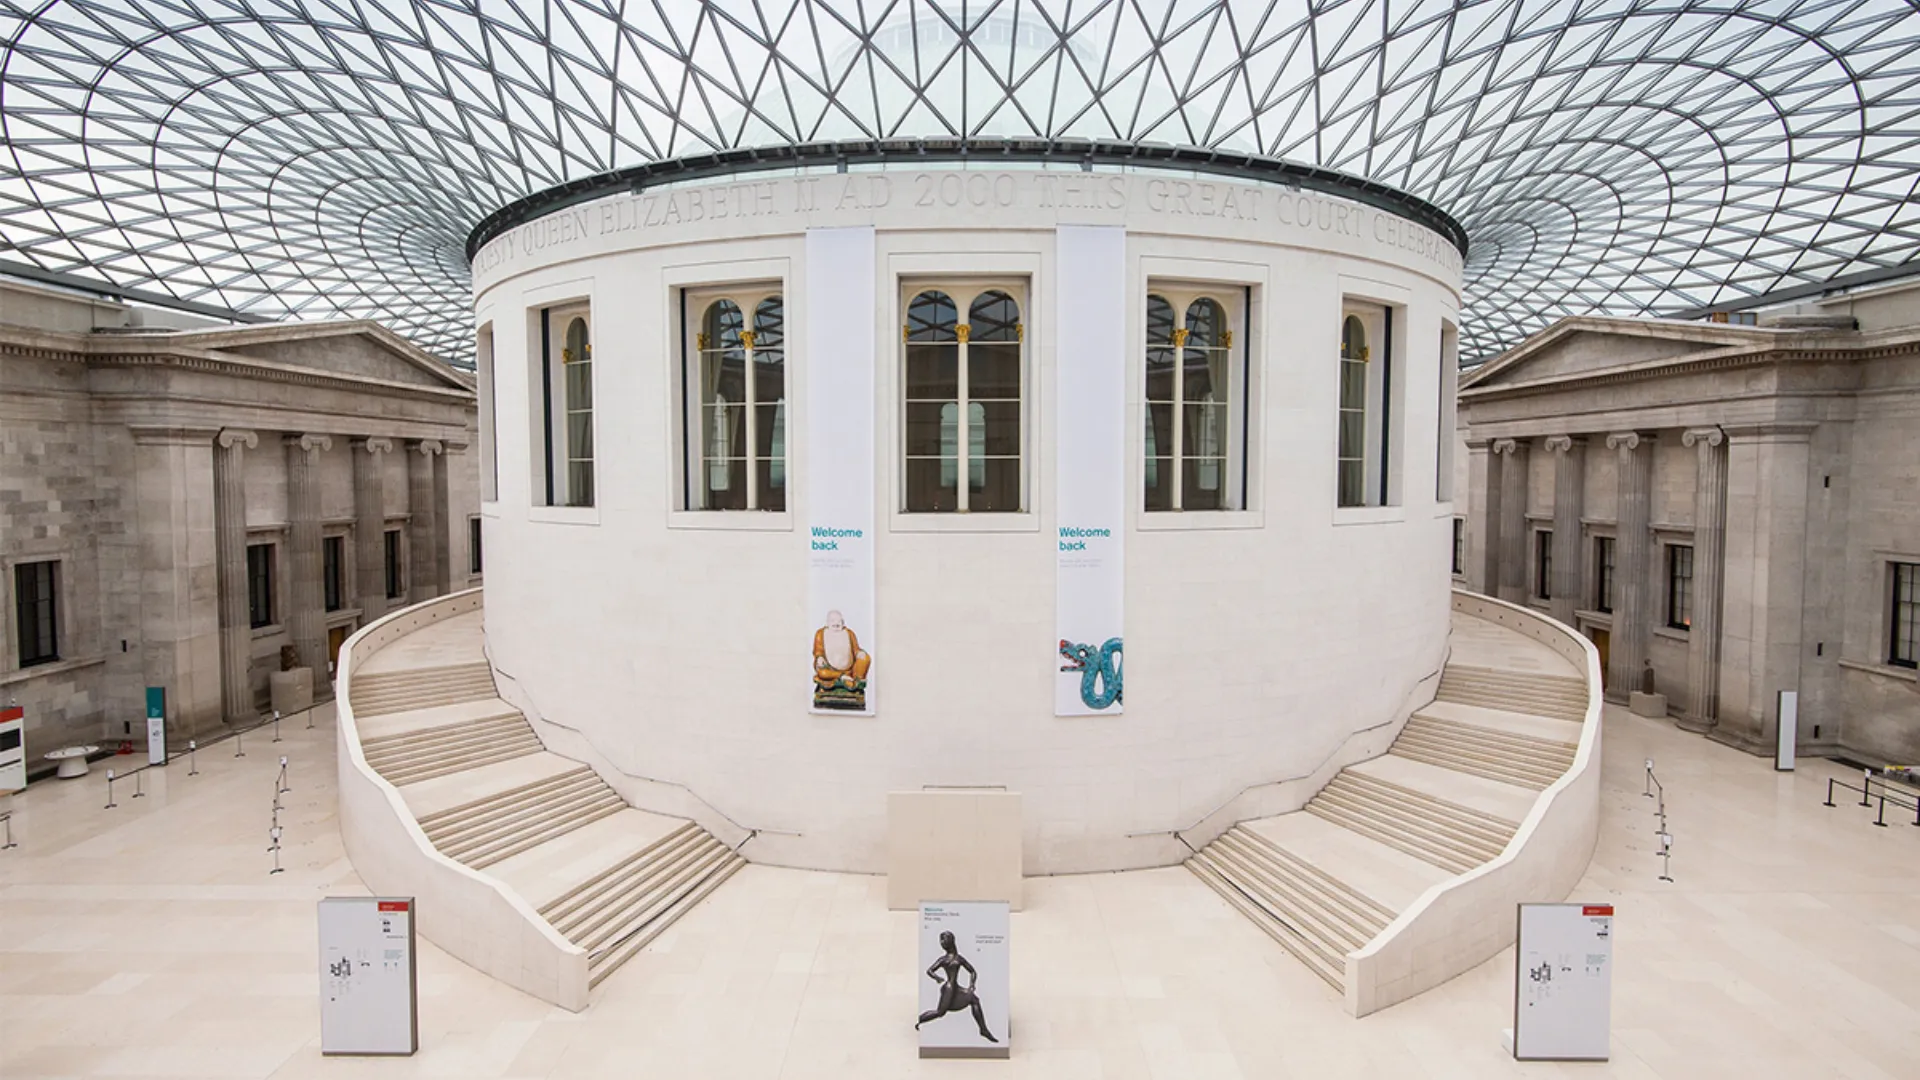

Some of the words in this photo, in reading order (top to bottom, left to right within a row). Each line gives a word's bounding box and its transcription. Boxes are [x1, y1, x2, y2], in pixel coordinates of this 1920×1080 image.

[523, 208, 589, 256] QUEEN
[599, 181, 779, 235] ELIZABETH
[794, 177, 820, 212] II
[835, 175, 893, 211] AD
[914, 173, 1016, 207] 2000
[1033, 174, 1127, 210] THIS
[1146, 179, 1263, 221] GREAT
[1277, 193, 1364, 238] COURT
[811, 526, 863, 538] Welcome
[1059, 526, 1111, 538] Welcome
[811, 540, 838, 551] back
[1059, 540, 1086, 551] back
